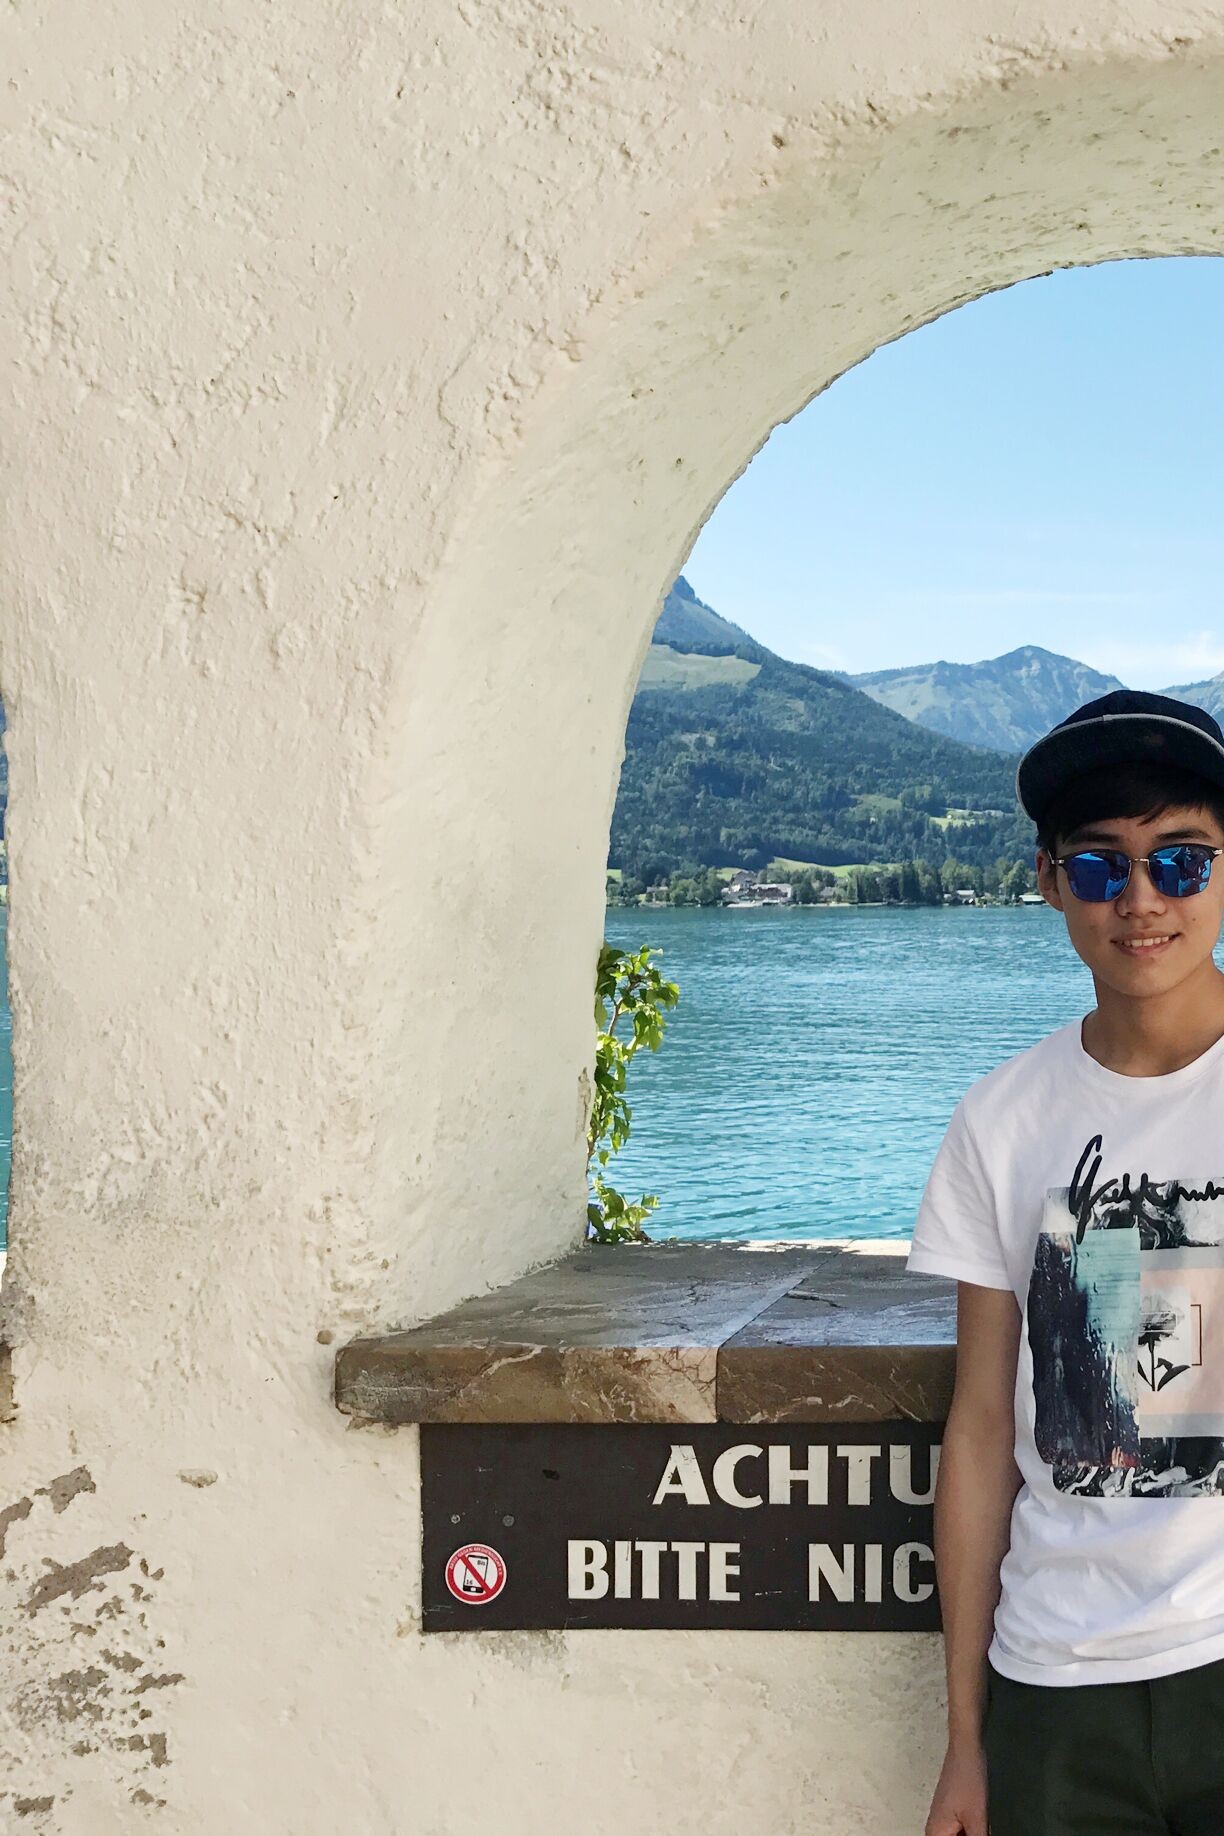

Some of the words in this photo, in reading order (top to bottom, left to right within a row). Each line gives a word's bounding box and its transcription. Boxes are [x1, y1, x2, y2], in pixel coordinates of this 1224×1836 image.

[652, 1444, 942, 1509] ACHTU
[567, 1539, 741, 1602] BITTE
[808, 1541, 935, 1603] NIC
